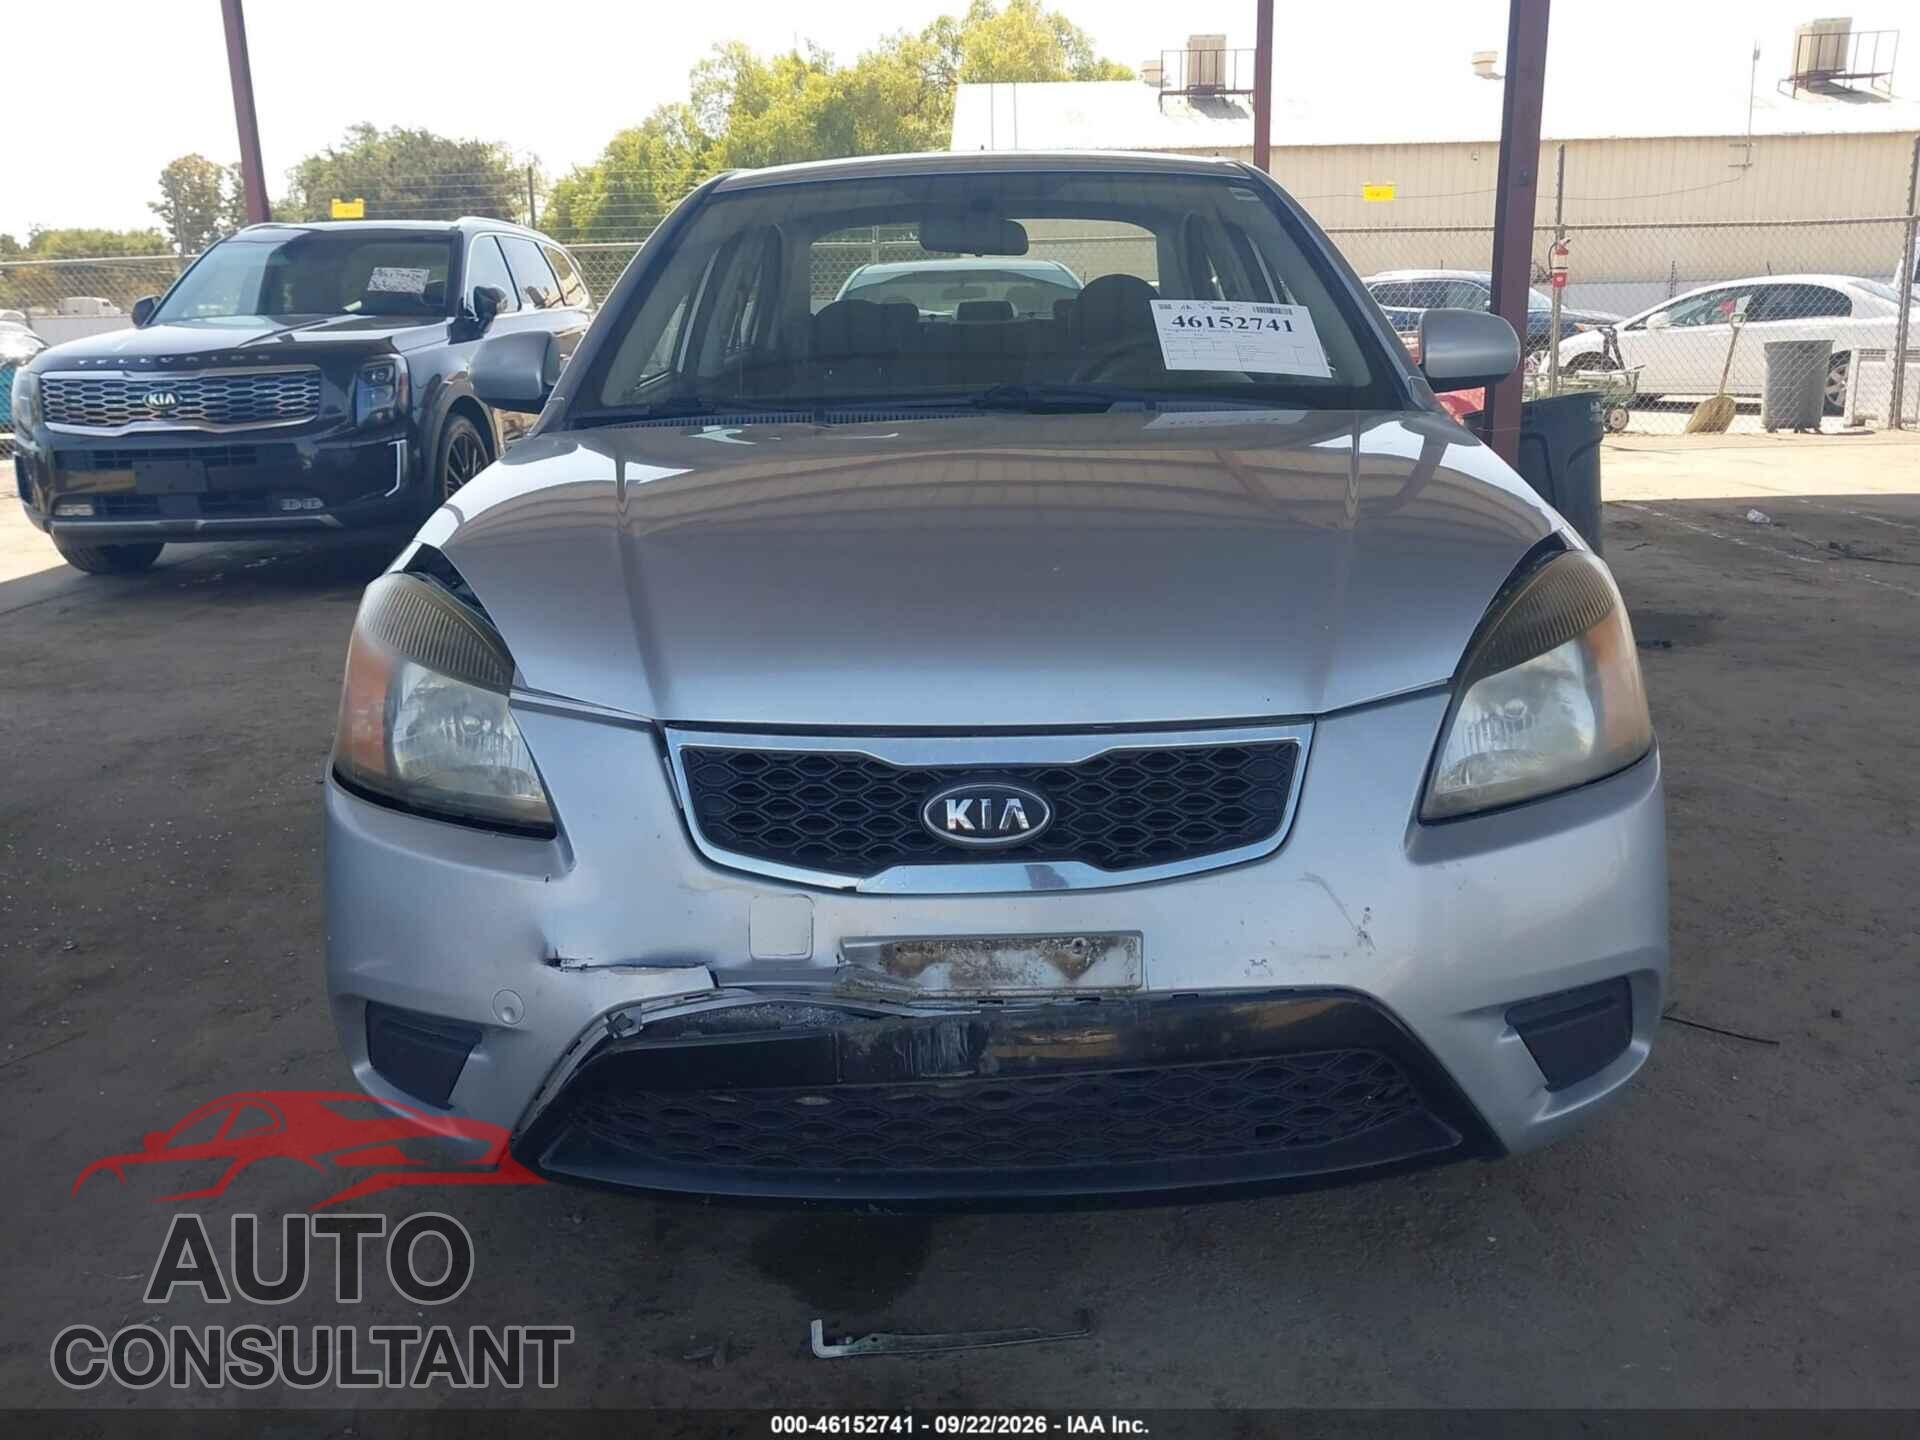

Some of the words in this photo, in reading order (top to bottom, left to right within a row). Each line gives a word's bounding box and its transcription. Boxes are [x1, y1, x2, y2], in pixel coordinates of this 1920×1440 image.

[1171, 314, 1294, 332] 46152741
[149, 392, 176, 405] KIA
[944, 798, 1030, 831] KIA
